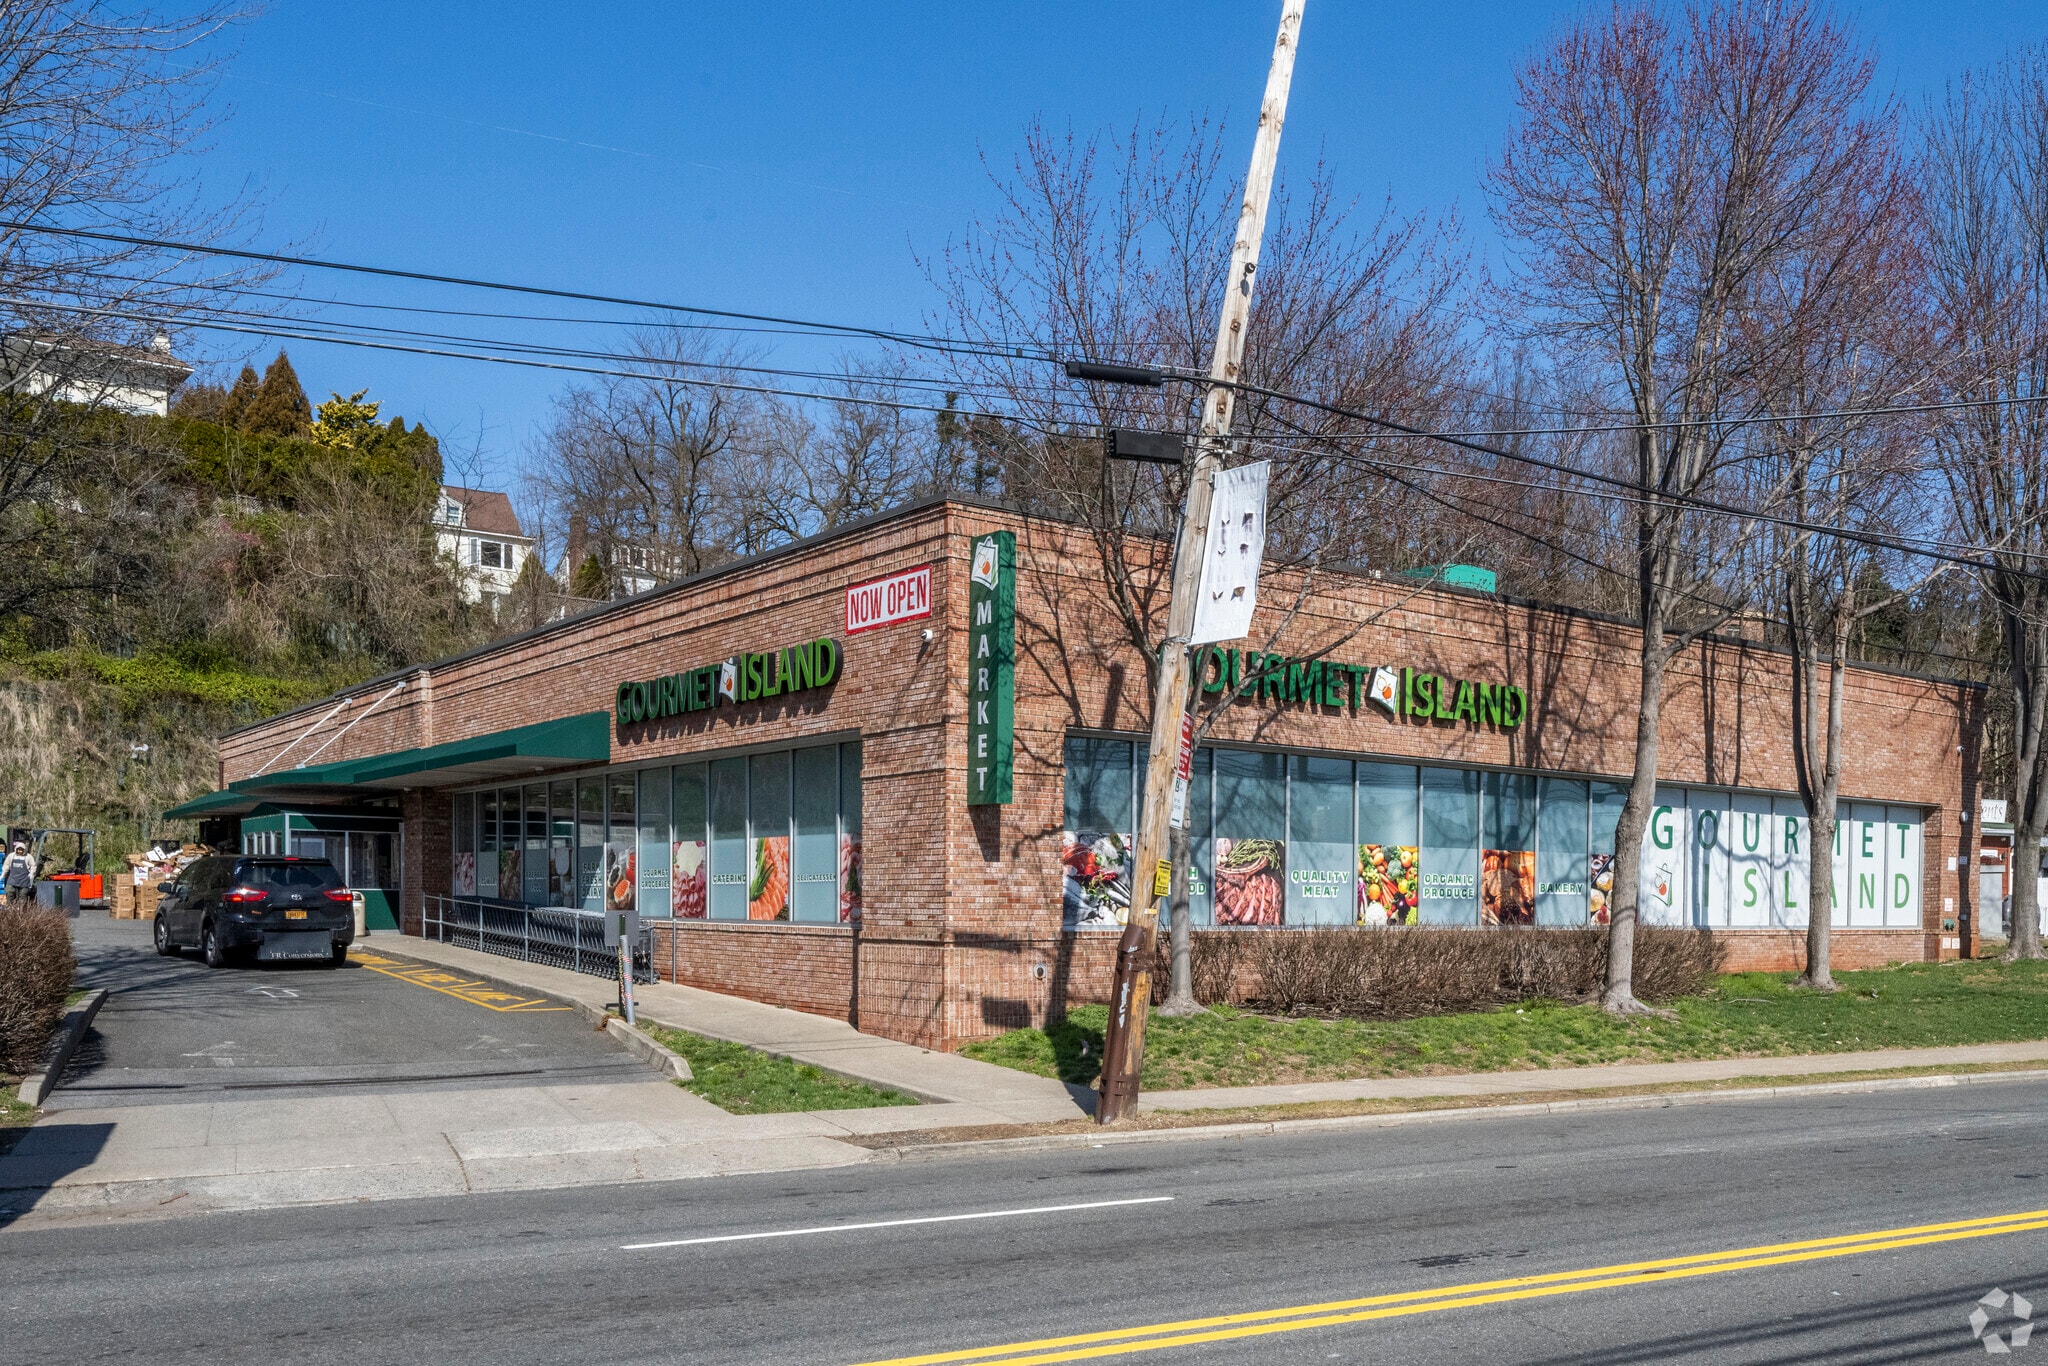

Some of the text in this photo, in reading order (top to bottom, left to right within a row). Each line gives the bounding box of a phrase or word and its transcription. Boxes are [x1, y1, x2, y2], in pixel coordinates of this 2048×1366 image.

[850, 573, 927, 625] NOW OPEN
[616, 637, 841, 724] GOURMET ISLAND
[1157, 641, 1527, 728] OURMET ISLAND
[976, 599, 992, 792] MARKET
[642, 868, 669, 878] GOURMET
[712, 873, 747, 885] CATERING
[796, 873, 837, 883] DELICATESSEN
[1291, 870, 1349, 883] QUALITY
[1423, 874, 1474, 885] ORGANIC
[640, 880, 670, 889] GROCERIES
[1538, 881, 1584, 895] BAKERY
[1302, 885, 1339, 898] MEAT
[1423, 887, 1474, 899] PRODUCE
